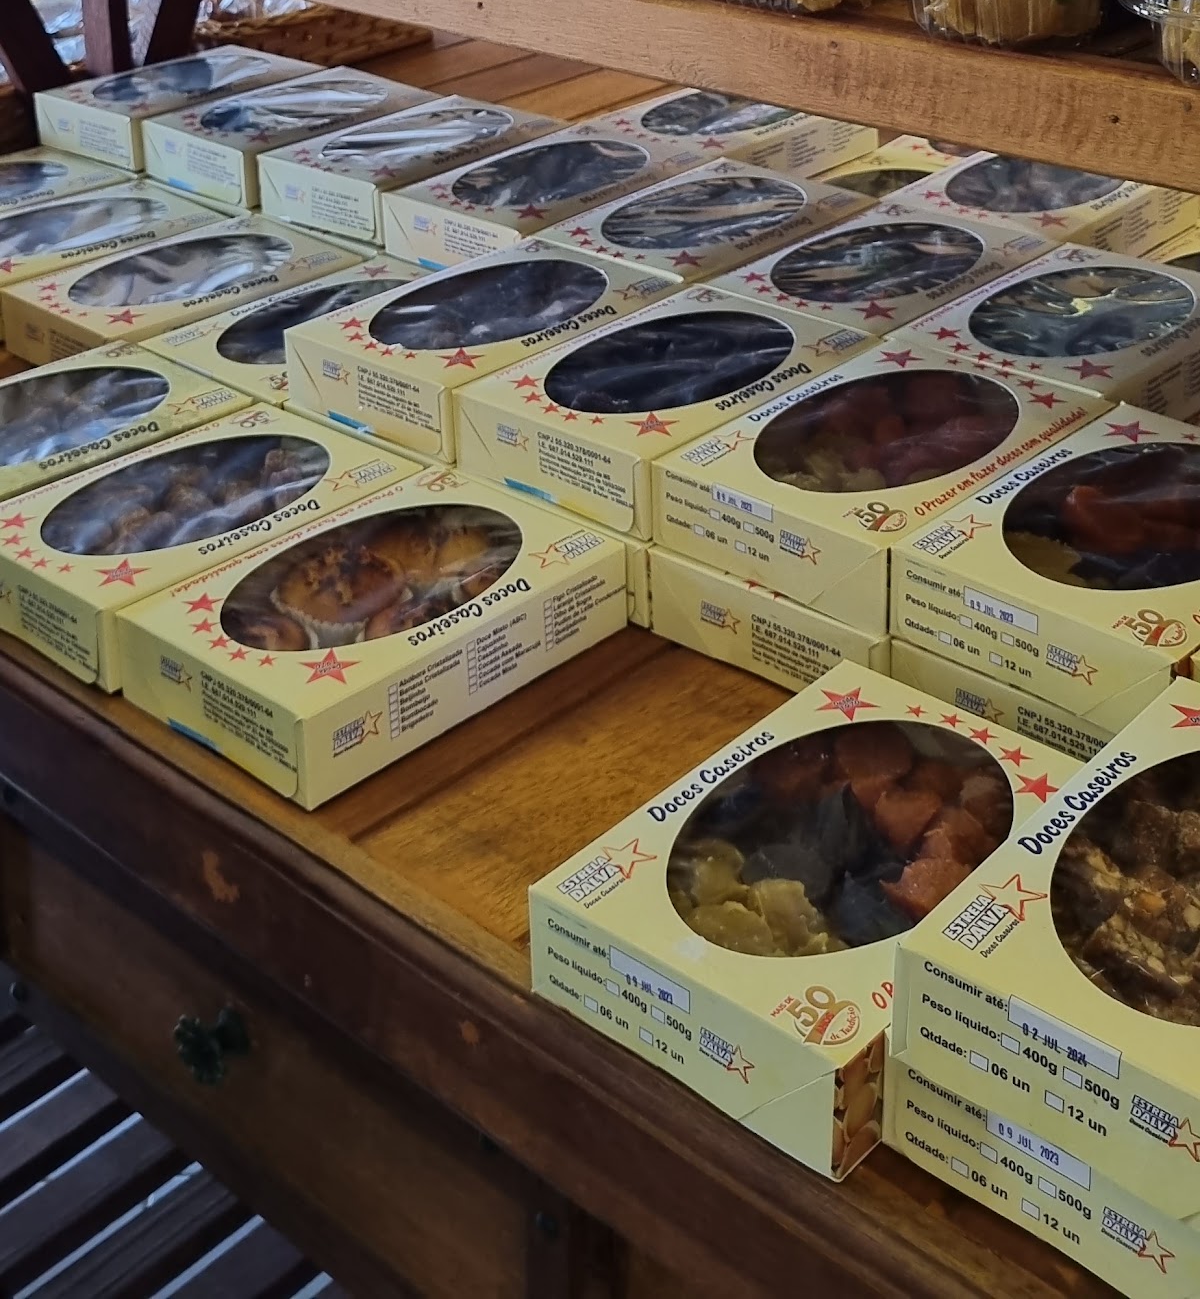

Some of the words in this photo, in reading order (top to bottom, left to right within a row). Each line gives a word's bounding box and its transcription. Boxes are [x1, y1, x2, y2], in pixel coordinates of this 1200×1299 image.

[577, 305, 618, 324] Doces
[520, 322, 580, 347] Caseiros
[772, 363, 812, 383] Doces
[715, 381, 776, 411] Caseiros
[747, 400, 788, 422] Doces
[786, 374, 844, 402] Caseiros
[923, 487, 958, 512] Prazer
[957, 479, 974, 492] em
[969, 463, 998, 483] fazer
[997, 447, 1023, 467] doces
[1021, 436, 1041, 451] com
[1038, 406, 1089, 443] qualidade!
[665, 470, 698, 488] Consumir
[976, 478, 1018, 505] Doces
[1014, 447, 1074, 483] Caseiros
[275, 499, 321, 522] Doces
[665, 492, 684, 505] Peso
[856, 501, 890, 524] 50
[721, 513, 741, 530] 400g
[754, 526, 775, 543] 500g
[913, 522, 952, 550] ESTRELA
[198, 522, 272, 555] Caseiros
[705, 530, 716, 540] 06
[717, 534, 728, 545] un
[924, 530, 963, 555] DALVA
[747, 546, 757, 557] 12
[759, 551, 770, 562] un
[482, 577, 532, 607] Doces
[906, 569, 947, 592] Consumir
[751, 613, 771, 629] CNPJ
[905, 593, 927, 609] Peso
[928, 600, 960, 623] líquido:
[1124, 608, 1165, 636] 50
[407, 605, 484, 647] Caseiros
[904, 618, 937, 637] Qtdade:
[973, 621, 998, 640] 400g
[953, 637, 965, 650] 06
[967, 644, 980, 656] un
[1015, 638, 1040, 658] 500g
[1004, 659, 1017, 671] 12
[1019, 666, 1032, 678] un
[1016, 705, 1042, 722] CNPJ
[647, 782, 704, 823] Doces
[699, 730, 775, 785] Caseiros
[1018, 809, 1076, 855] Doces
[1063, 750, 1138, 812] Caseiros
[557, 855, 611, 895] ESTRELA
[568, 864, 622, 902] DALVA
[942, 894, 996, 941] ESTRELA
[958, 903, 1010, 950] DALVA
[547, 918, 591, 948] Consumir
[592, 944, 611, 960] até:
[980, 941, 998, 959] Doces
[995, 919, 1020, 945] Caseiros
[547, 947, 570, 966] Peso
[571, 960, 607, 986] líquido:
[549, 974, 582, 1002] Qtdade:
[621, 989, 647, 1013] 400g
[657, 987, 674, 1005] 2023
[871, 991, 888, 1009] O
[924, 961, 983, 999] Consumir
[985, 993, 1008, 1013] até:
[600, 1004, 613, 1020] 06
[615, 1014, 629, 1030] un
[770, 1005, 785, 1018] MAIS
[784, 996, 795, 1006] DE
[787, 985, 836, 1028] 50
[922, 993, 952, 1017] Peso
[955, 1010, 1001, 1043] líquido:
[666, 1015, 692, 1041] 500g
[700, 1027, 734, 1052] ESTRELA
[920, 1027, 967, 1058] Qtdade:
[655, 1038, 668, 1054] 12
[670, 1047, 685, 1064] un
[699, 1037, 732, 1063] DALVA
[1023, 1046, 1058, 1076] 400g
[1042, 1034, 1061, 1053] JUL
[1066, 1046, 1089, 1068] 2024
[991, 1063, 1008, 1081] 06
[1012, 1073, 1031, 1093] un
[908, 1068, 962, 1107] Consumir
[965, 1101, 987, 1122] até:
[1084, 1079, 1121, 1110] 500g
[906, 1099, 934, 1123] Peso
[937, 1117, 980, 1150] líquido:
[1067, 1104, 1085, 1123] 12
[1088, 1118, 1108, 1137] un
[1130, 1106, 1177, 1137] DALVA
[1132, 1095, 1180, 1126] ESTRELA
[905, 1131, 949, 1164] Qtdade:
[1017, 1133, 1034, 1152] JUL
[1040, 1145, 1060, 1166] 2023
[971, 1170, 987, 1188] 06
[991, 1182, 1008, 1200] un
[1000, 1156, 1034, 1185] 400g
[1058, 1189, 1092, 1220] 500g
[1043, 1213, 1059, 1231] 12
[1063, 1225, 1081, 1245] un
[1102, 1216, 1146, 1247] DALVA
[1103, 1206, 1148, 1239] ESTRELA
